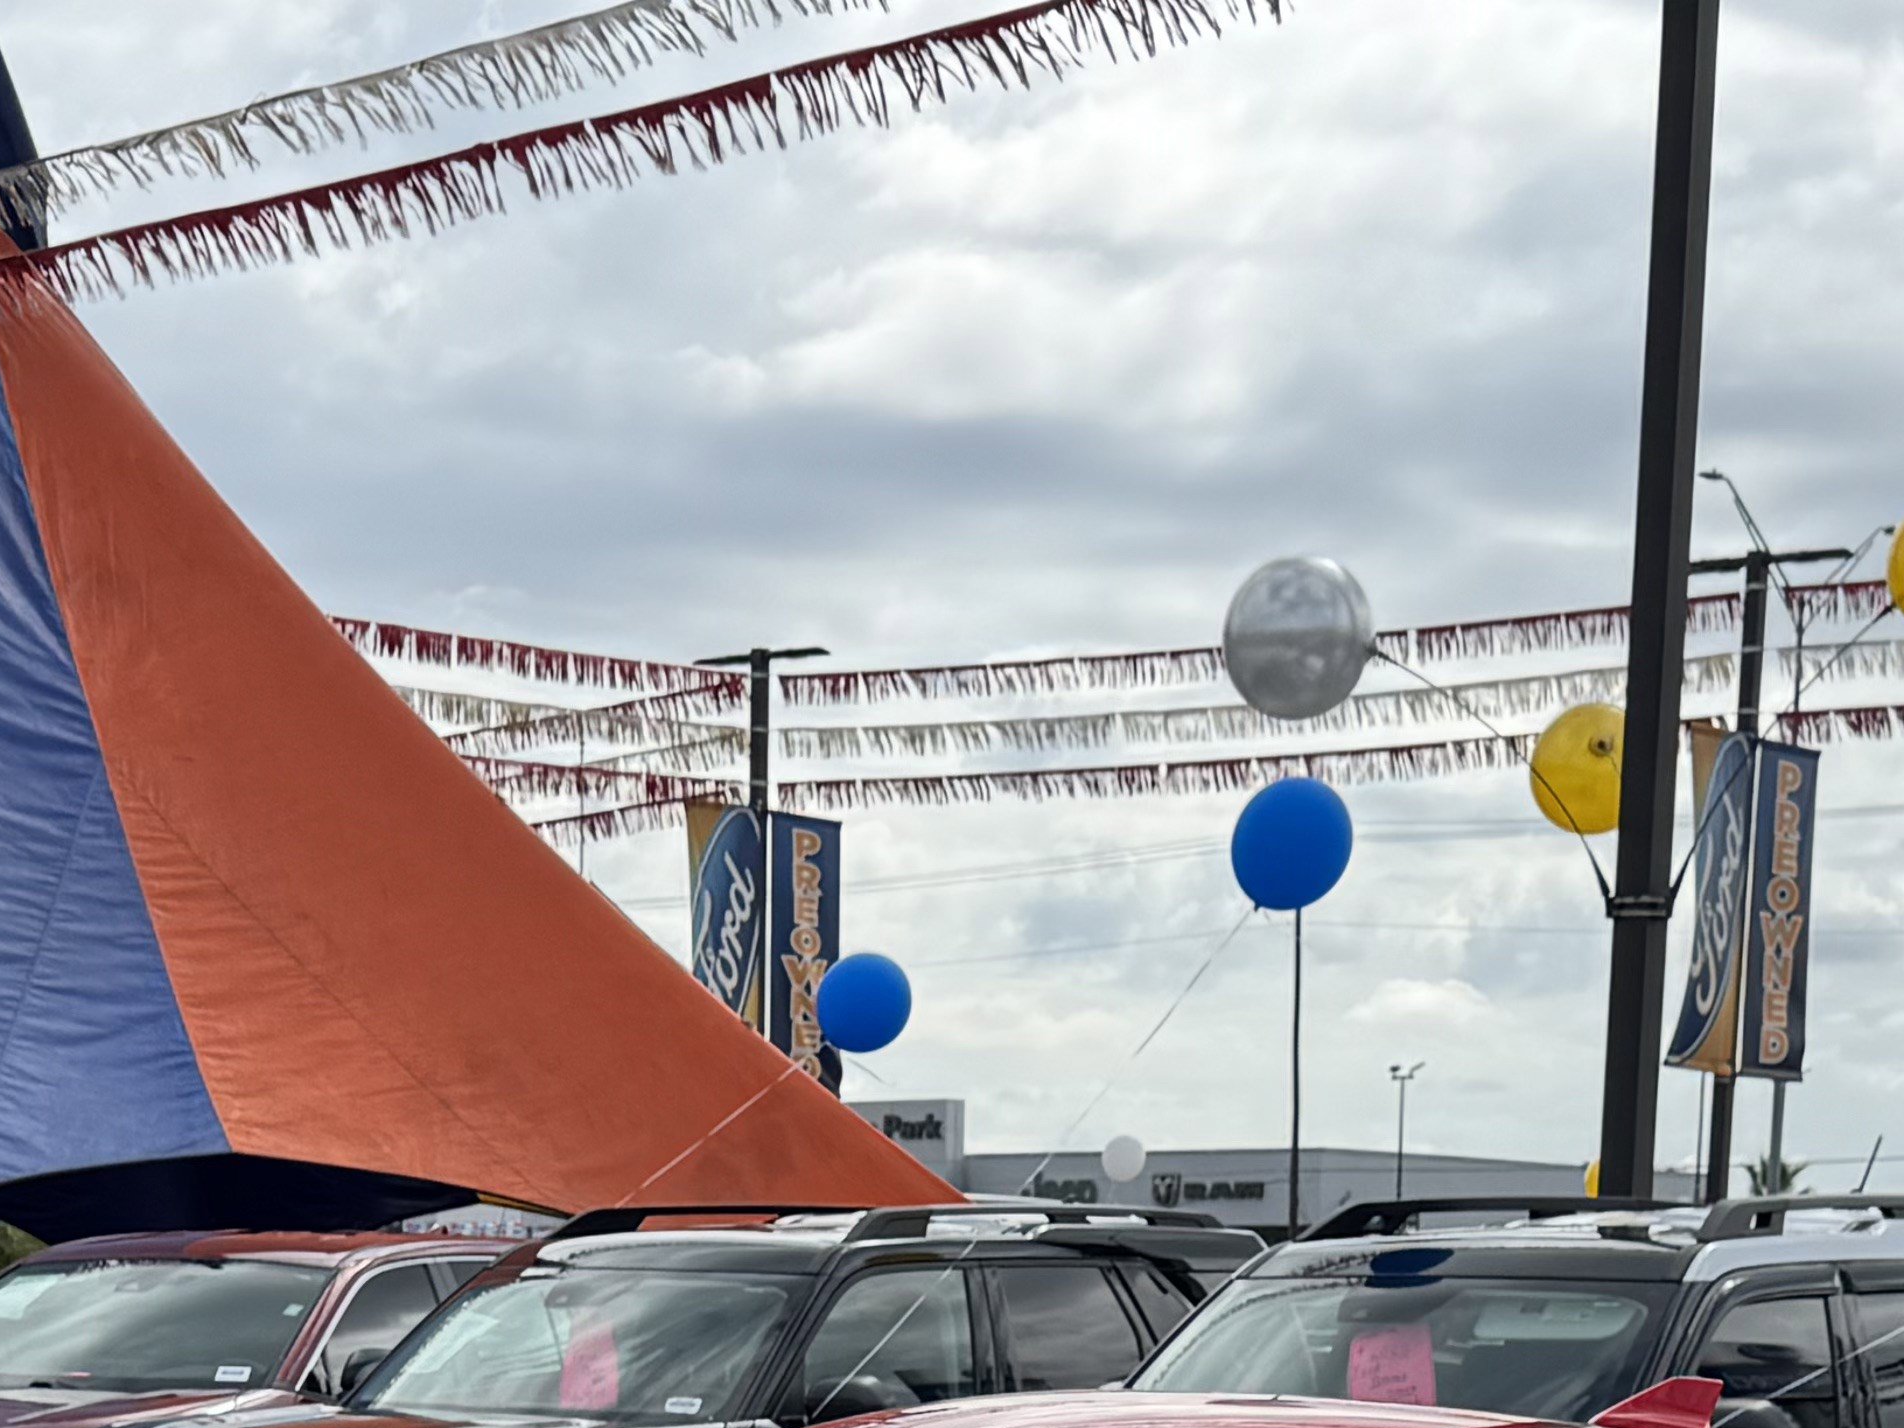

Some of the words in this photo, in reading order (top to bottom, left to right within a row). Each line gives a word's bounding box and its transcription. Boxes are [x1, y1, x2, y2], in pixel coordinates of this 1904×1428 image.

[1691, 791, 1744, 1016] Ford
[1758, 759, 1803, 1065] PREOWNED
[882, 1113, 943, 1140] Park
[1183, 1181, 1265, 1201] RAM
